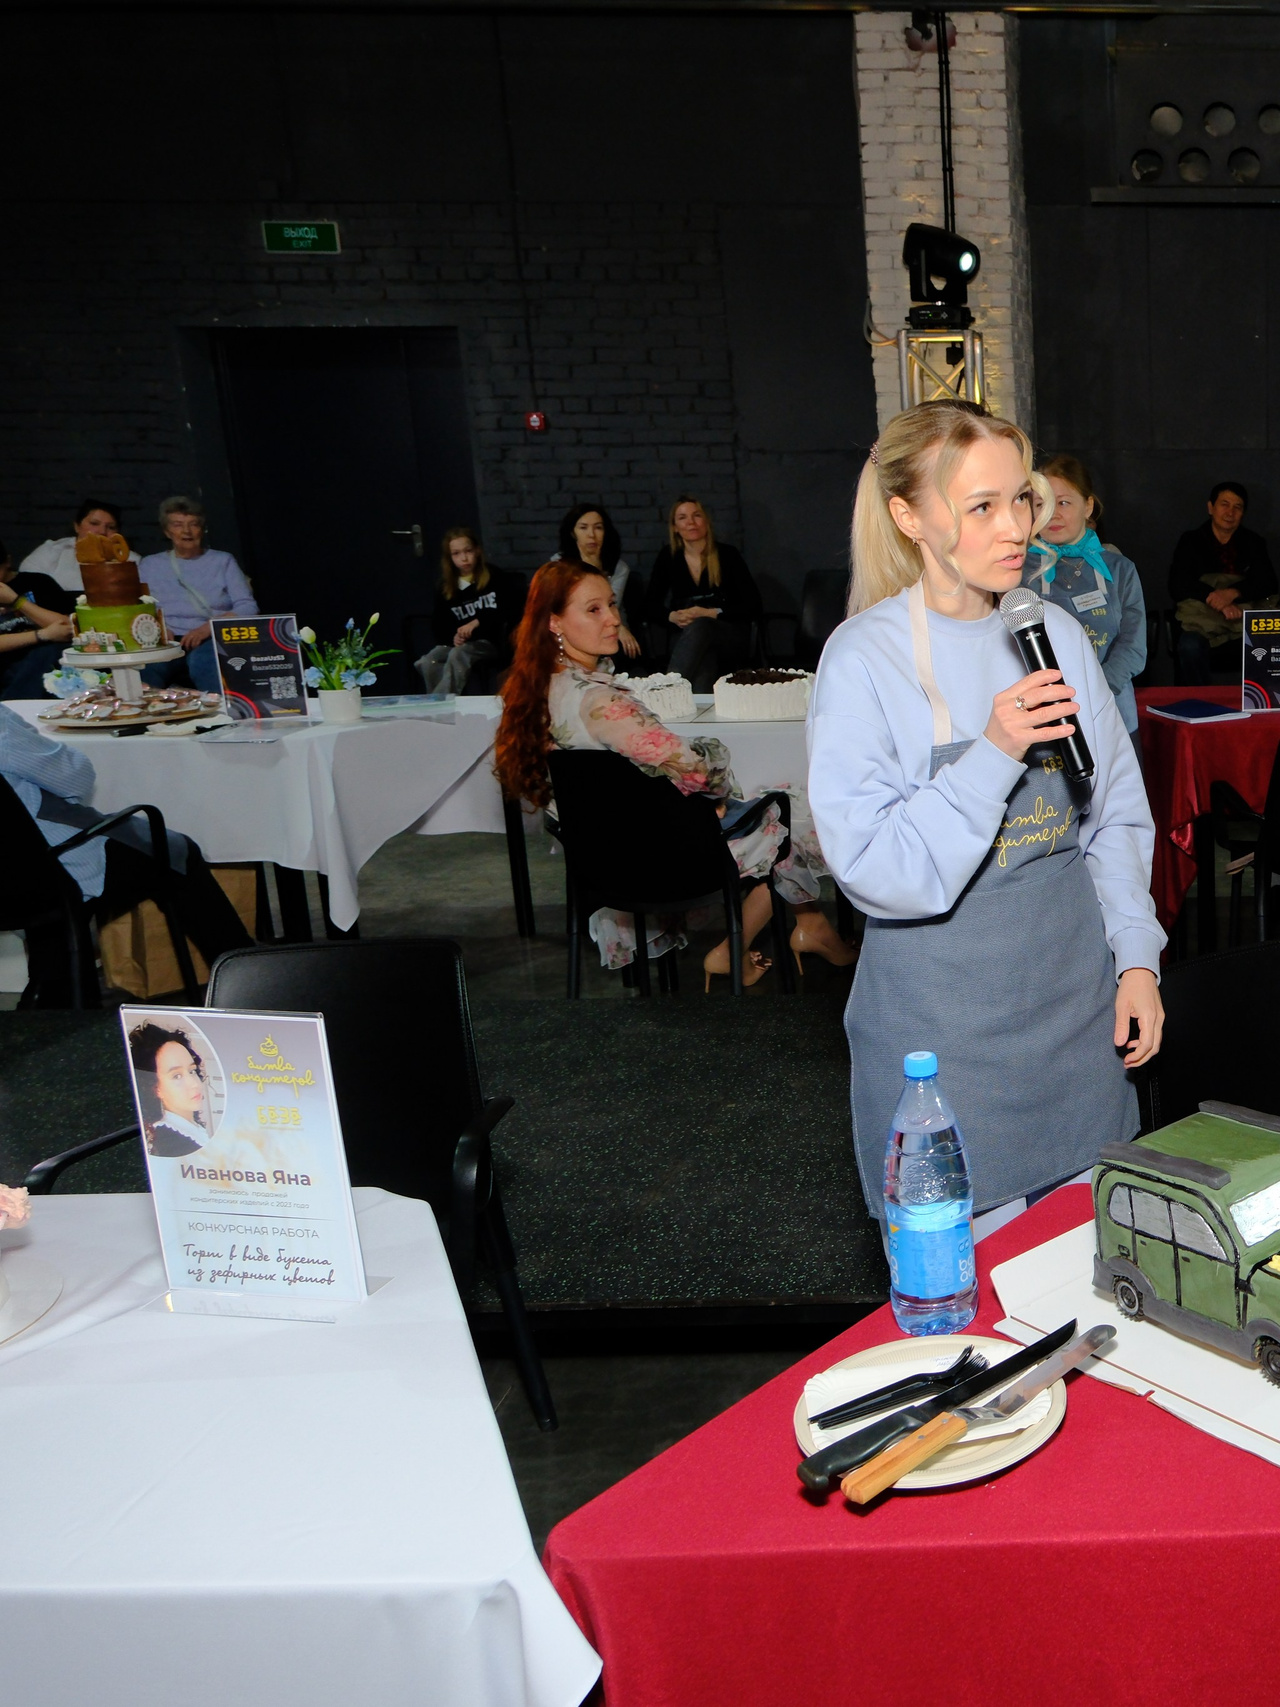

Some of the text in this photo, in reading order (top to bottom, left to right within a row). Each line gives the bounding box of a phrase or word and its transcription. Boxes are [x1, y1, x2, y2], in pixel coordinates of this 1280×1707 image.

[284, 227, 318, 239] ВЫХОД
[292, 240, 312, 248] EXIT
[1001, 796, 1058, 828] итва
[992, 805, 1073, 867] дитеров
[247, 1056, 296, 1072] битва
[231, 1069, 316, 1099] кондитеров
[180, 1164, 312, 1187] Иванова Яна
[190, 1196, 238, 1205] кондитерских
[239, 1199, 269, 1207] изделий
[208, 1188, 288, 1198] занимаюсь продажей
[188, 1221, 320, 1239] КОНКУРСНАЯ РАБОТА
[183, 1243, 332, 1270] Торт в виде букета
[187, 1265, 335, 1285] из зефирных цветов
